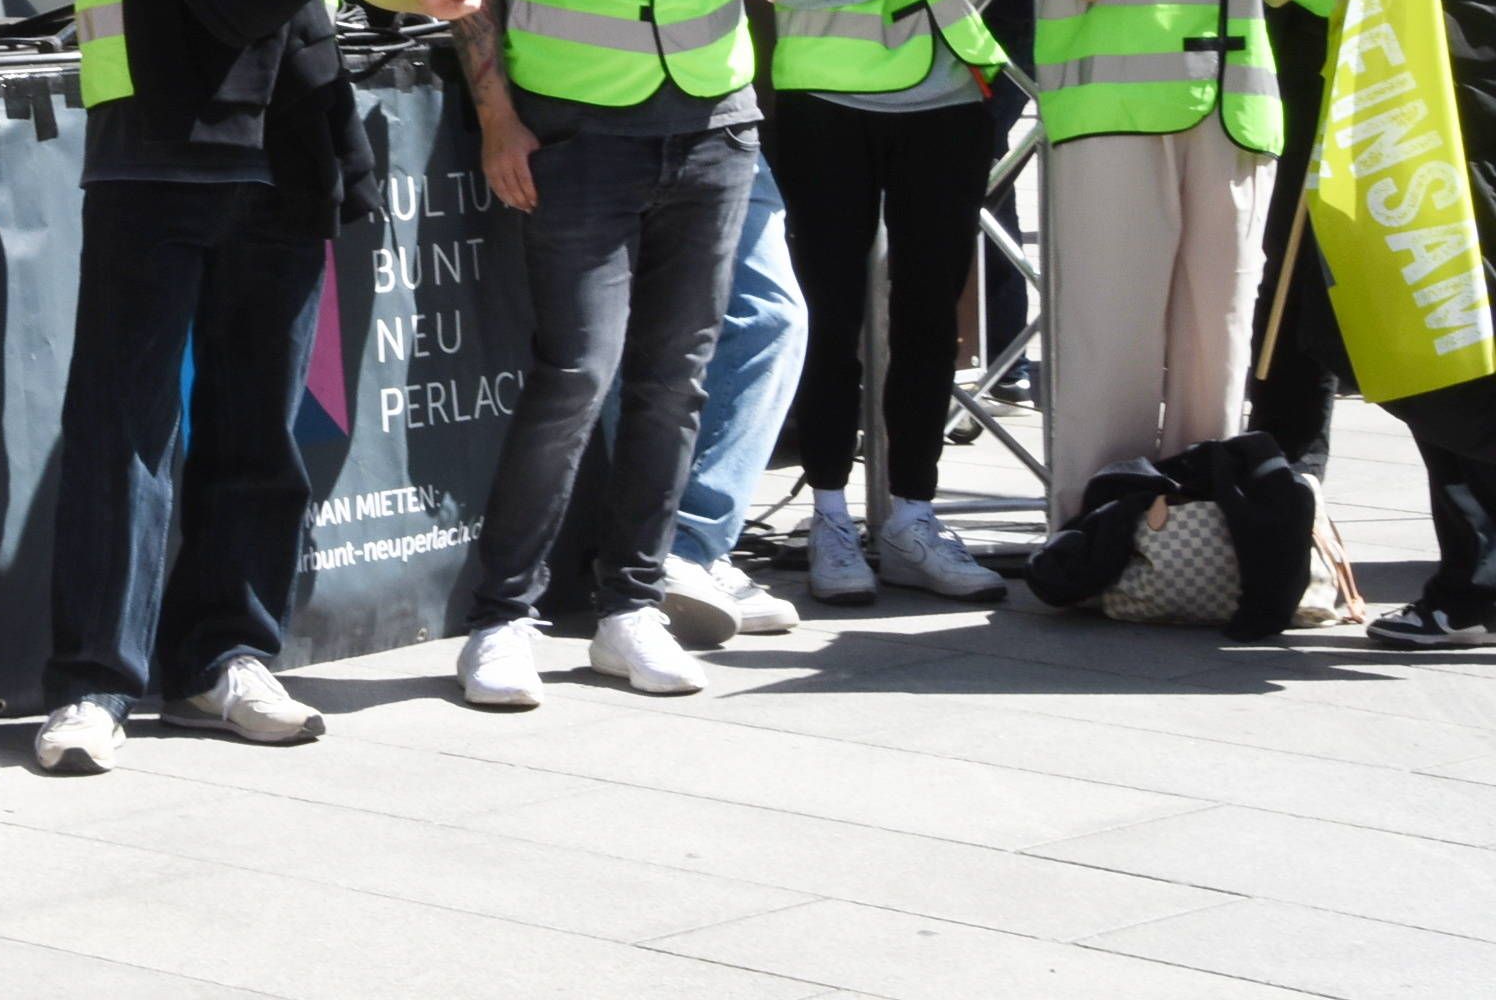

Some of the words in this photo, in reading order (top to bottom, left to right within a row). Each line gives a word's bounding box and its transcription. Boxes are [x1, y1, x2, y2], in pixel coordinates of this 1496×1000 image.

[373, 238, 484, 293] BUNT
[376, 310, 462, 363] NEU
[380, 370, 524, 433] PERLAC
